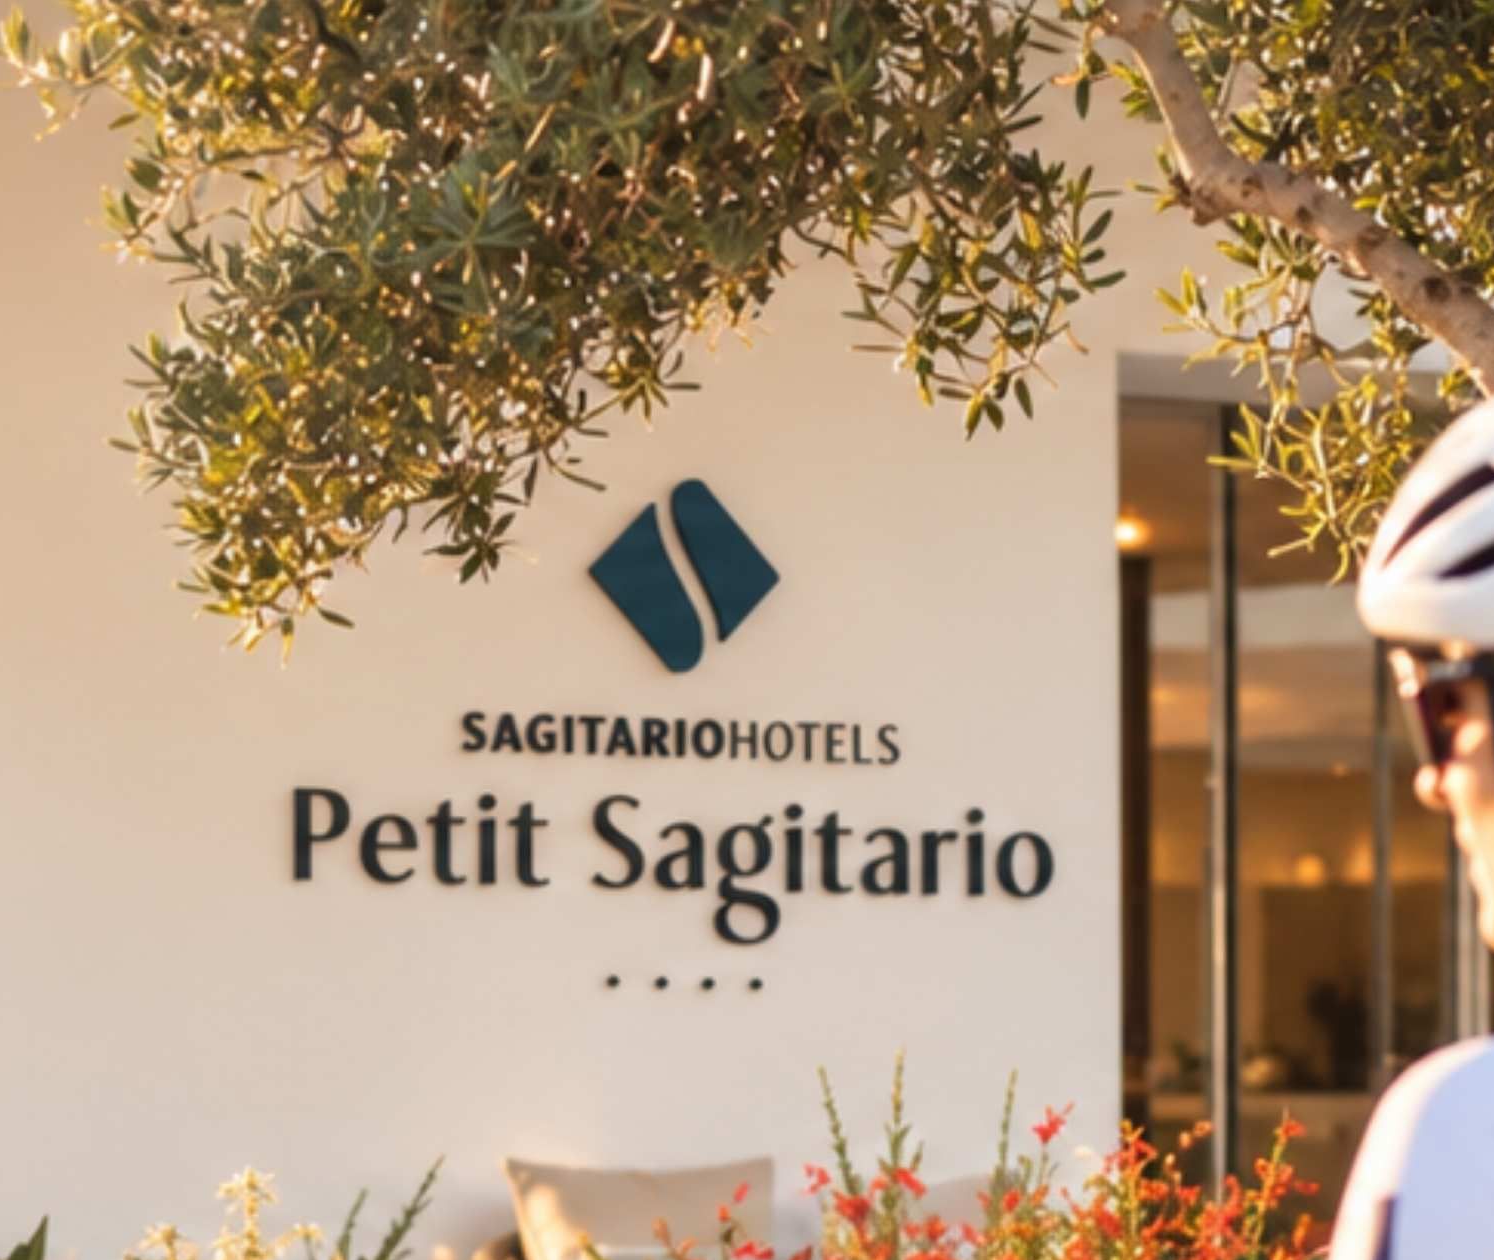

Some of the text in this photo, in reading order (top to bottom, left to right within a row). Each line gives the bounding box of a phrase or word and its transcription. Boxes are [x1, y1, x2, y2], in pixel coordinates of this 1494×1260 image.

[460, 710, 902, 766] SAGITARIOHOTELS
[291, 787, 1055, 945] Petit Sagitario
